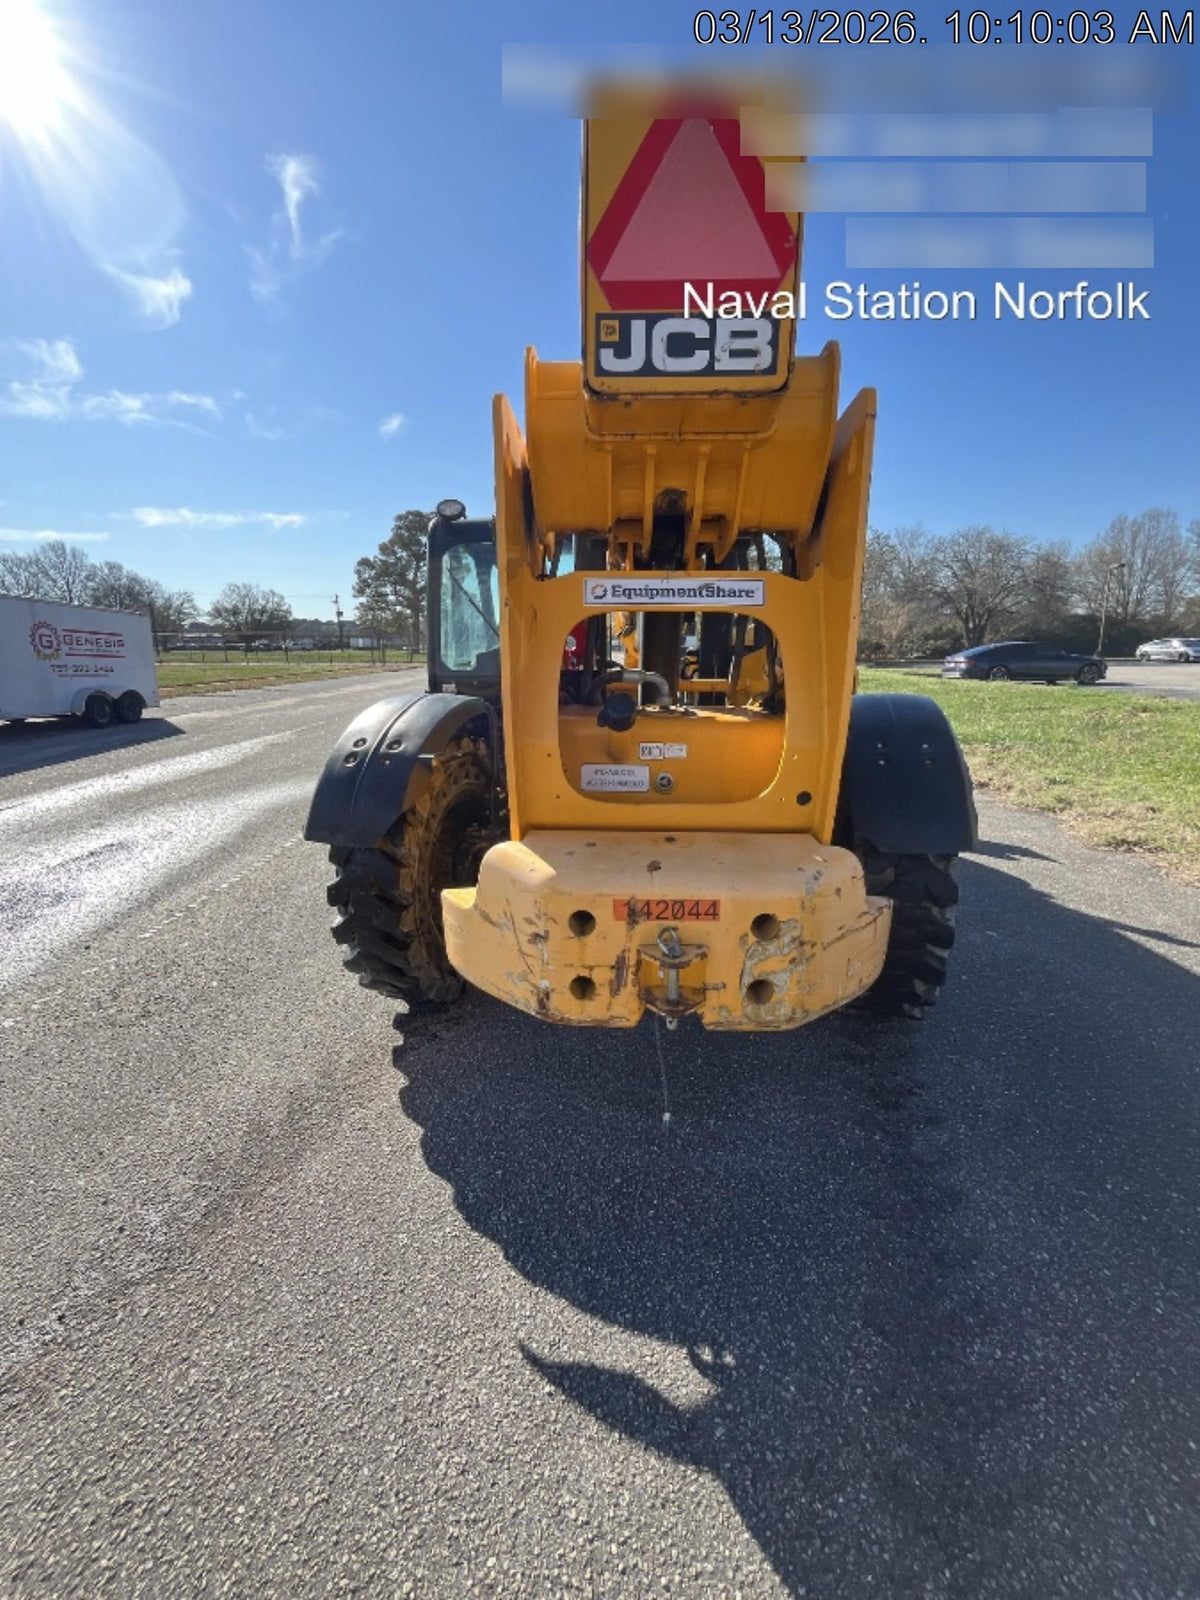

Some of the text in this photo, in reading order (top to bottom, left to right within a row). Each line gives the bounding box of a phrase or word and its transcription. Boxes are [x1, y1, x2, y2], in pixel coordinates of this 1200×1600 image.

[600, 318, 773, 372] JCB
[611, 583, 756, 600] EquipmentShare
[63, 634, 125, 648] GENESIS
